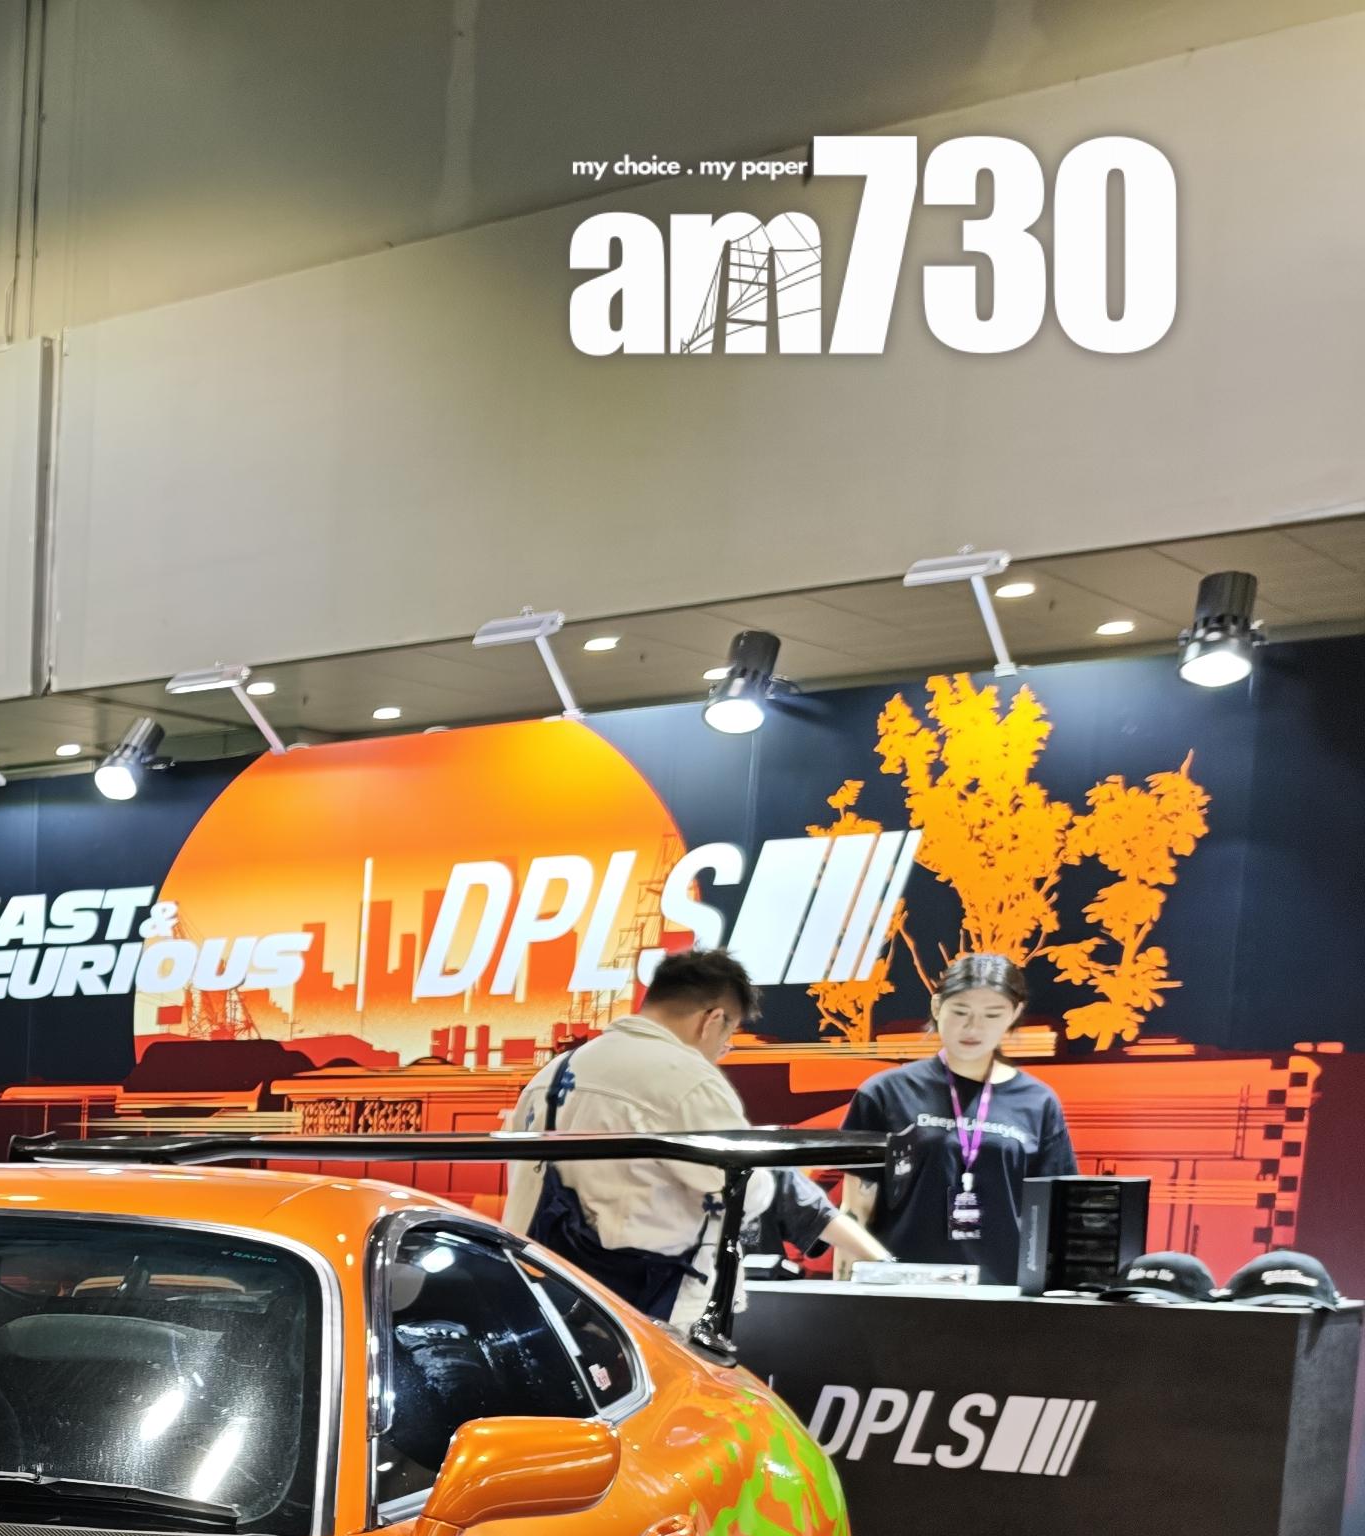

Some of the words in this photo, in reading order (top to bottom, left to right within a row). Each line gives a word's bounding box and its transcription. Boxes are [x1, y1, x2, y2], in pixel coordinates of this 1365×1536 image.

[141, 900, 180, 938] &
[414, 842, 744, 1000] DPLS
[805, 1384, 997, 1469] DPLS
